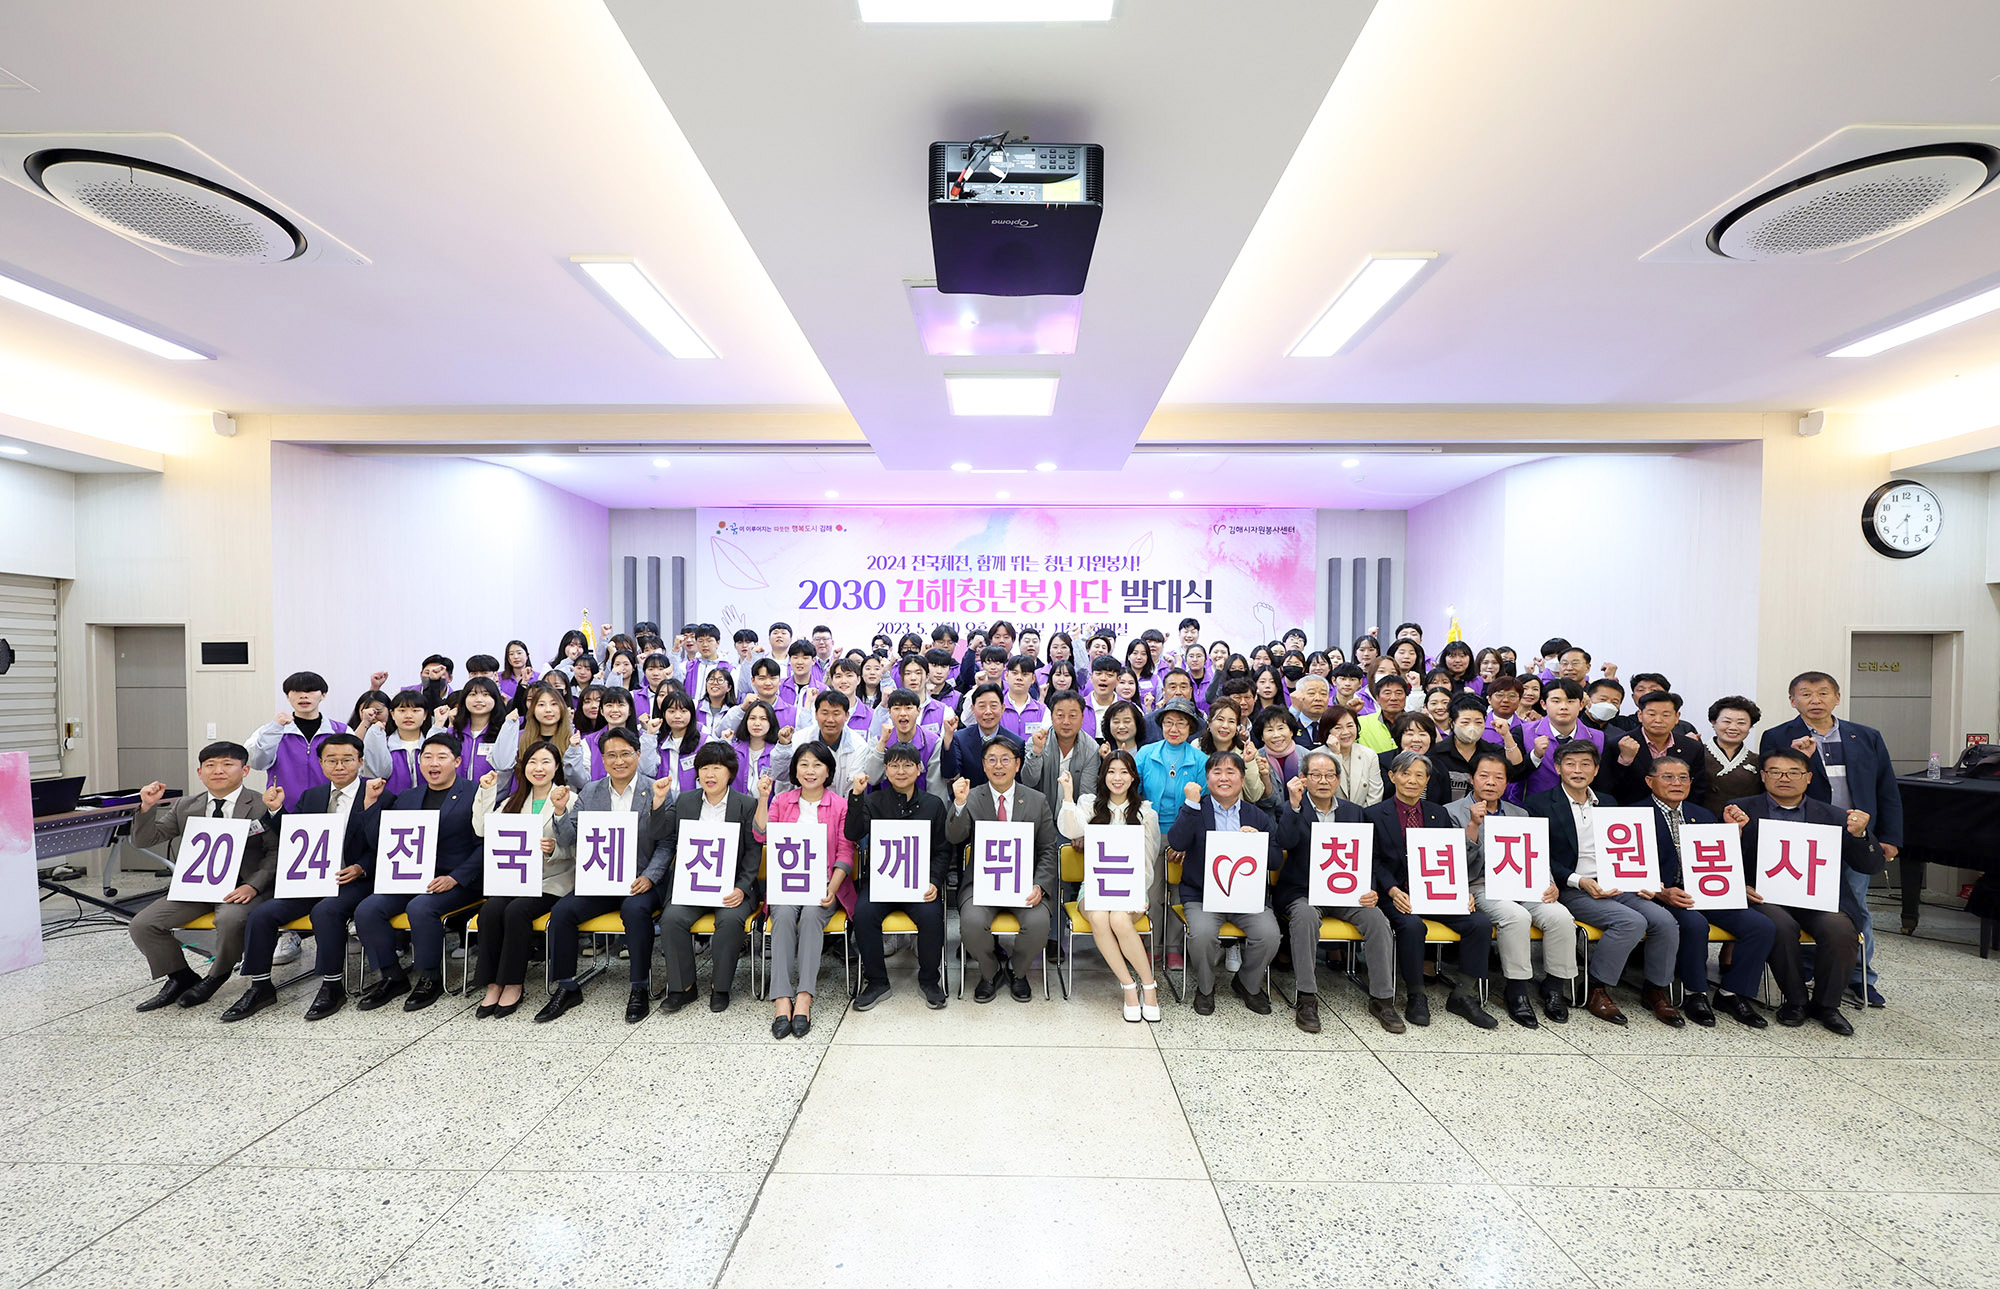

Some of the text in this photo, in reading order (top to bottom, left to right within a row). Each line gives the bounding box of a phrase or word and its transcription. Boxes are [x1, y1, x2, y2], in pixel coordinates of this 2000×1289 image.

[991, 218, 1038, 229] Optoma
[746, 525, 772, 533] 이루어지는
[773, 525, 790, 533] 따뜻한
[792, 524, 818, 533] 행복도시
[820, 524, 832, 533] 김해
[1228, 525, 1296, 535] 김해시자원봉사센터
[1880, 515, 1887, 523] 9
[1883, 526, 1890, 534] 8
[1922, 525, 1929, 533] 4
[1924, 503, 1931, 511] 2
[1926, 514, 1933, 522] 3
[866, 554, 1141, 573] 2024 전국체전, 함께 뛰는 청년 자원봉사!
[1892, 535, 1898, 543] 7
[1903, 537, 1909, 545] 6
[798, 578, 1213, 614] 2030 김해청년봉사단 발대식
[916, 621, 928, 636] 5.
[1857, 661, 1900, 672] 드레스실
[181, 832, 235, 886] 20
[286, 828, 332, 881] 24
[386, 825, 425, 881] 전
[491, 829, 533, 884] 국
[582, 827, 625, 882] 체
[685, 837, 725, 893] 전
[774, 836, 818, 892] 함
[876, 835, 920, 889] 께
[982, 837, 1022, 894] 뛰
[1092, 841, 1135, 897] 는
[1319, 836, 1360, 895] 청
[1417, 844, 1458, 900] 년
[1492, 832, 1539, 889] 자
[1605, 822, 1648, 879] 원
[1691, 839, 1734, 897] 봉
[1764, 839, 1828, 896] 사
